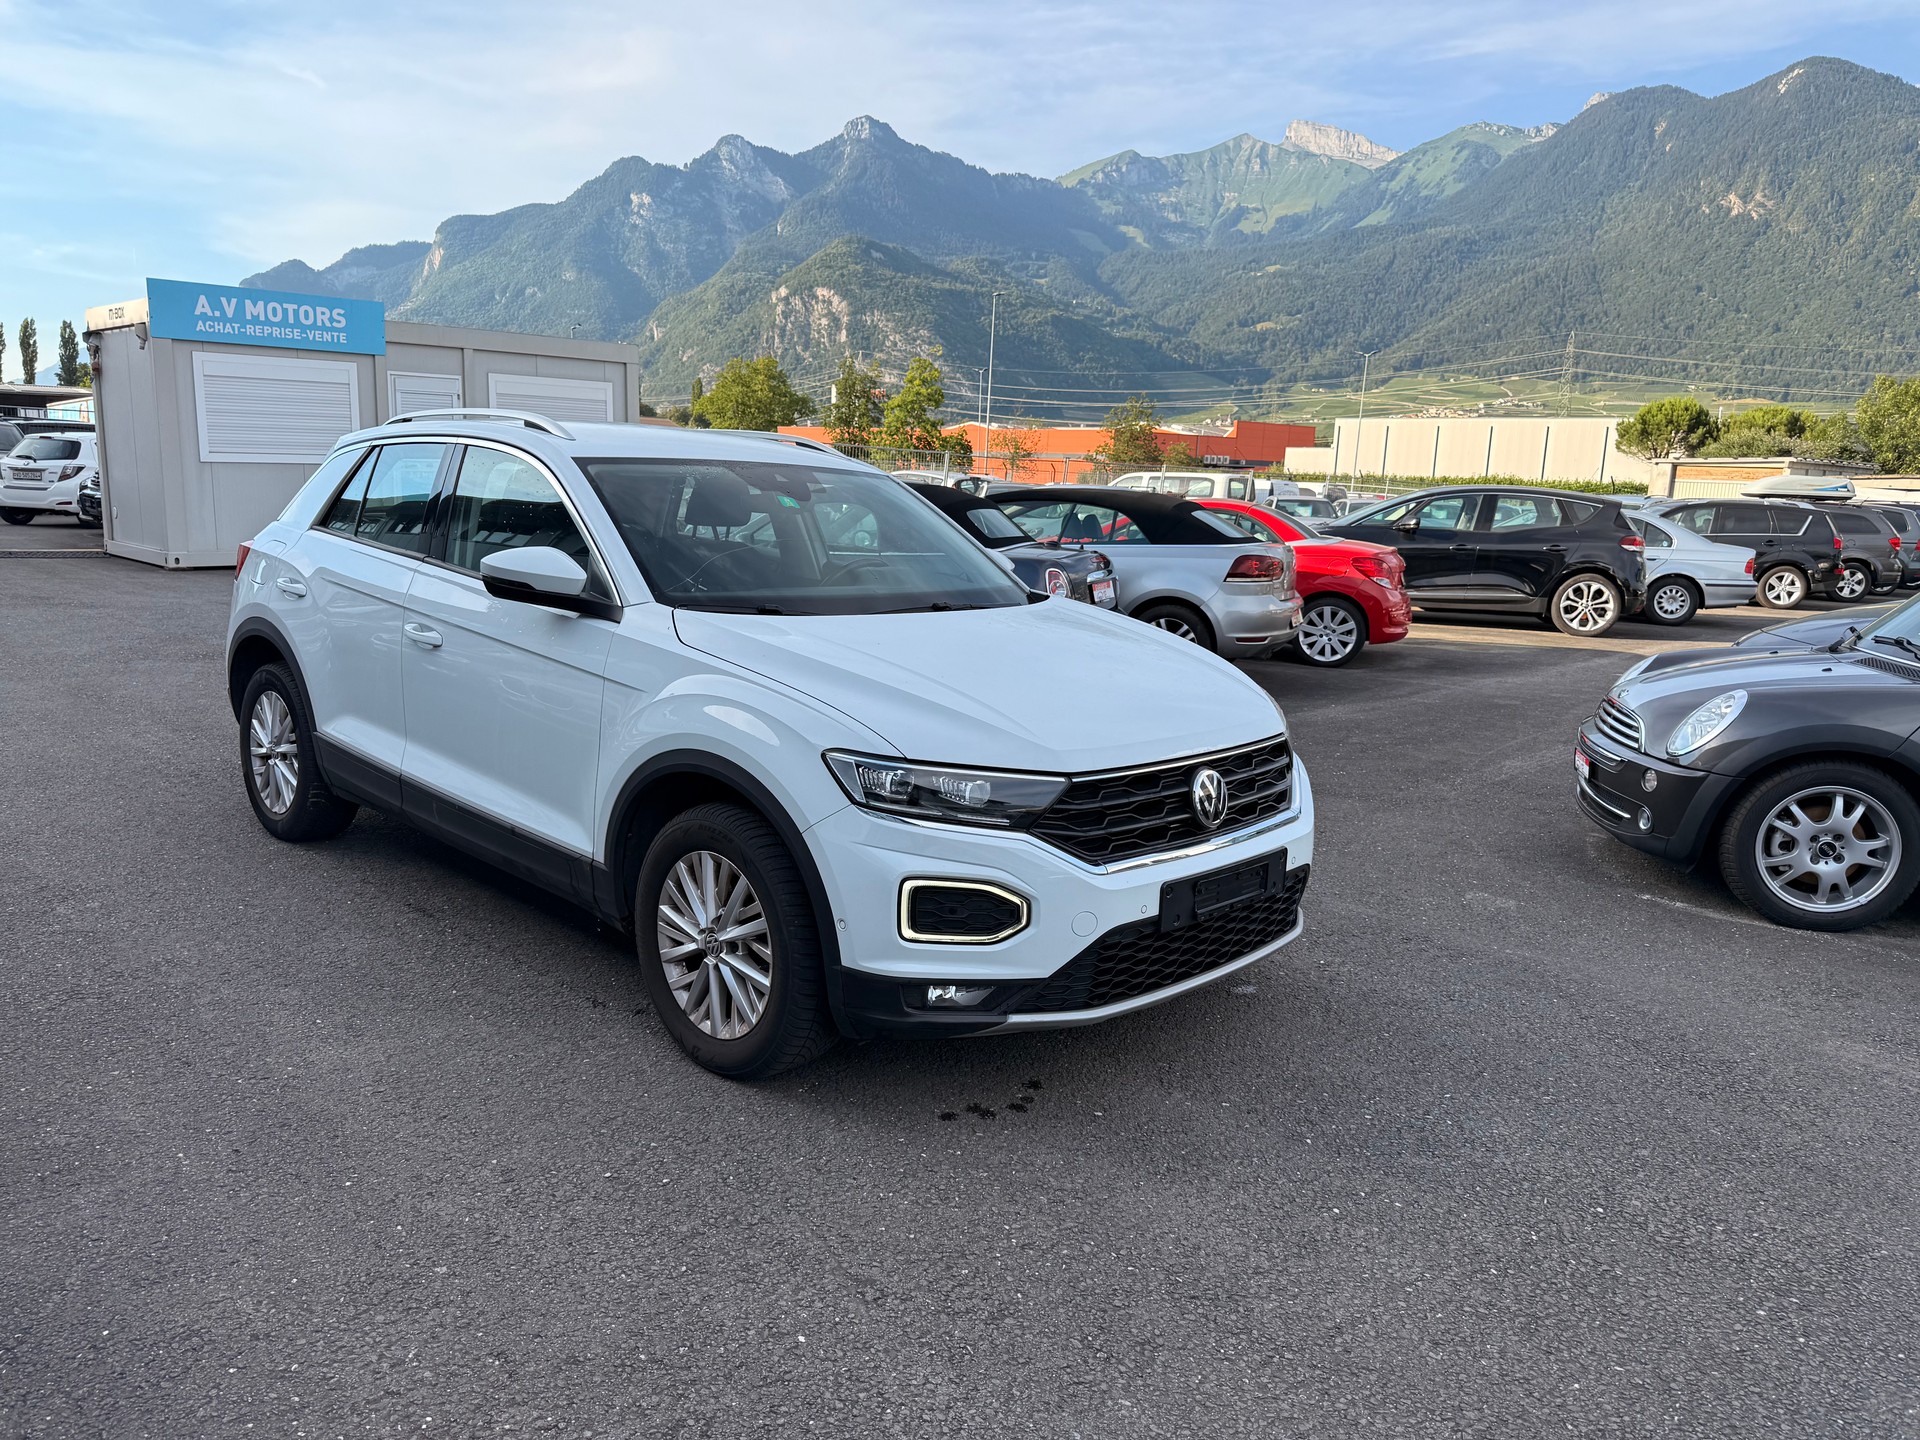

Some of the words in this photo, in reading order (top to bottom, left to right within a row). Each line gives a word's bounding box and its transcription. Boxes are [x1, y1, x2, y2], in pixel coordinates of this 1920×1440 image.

[194, 294, 238, 319] A.V
[244, 299, 347, 329] MOTORS
[196, 320, 348, 344] ACHAT-REPRISE-VENTE
